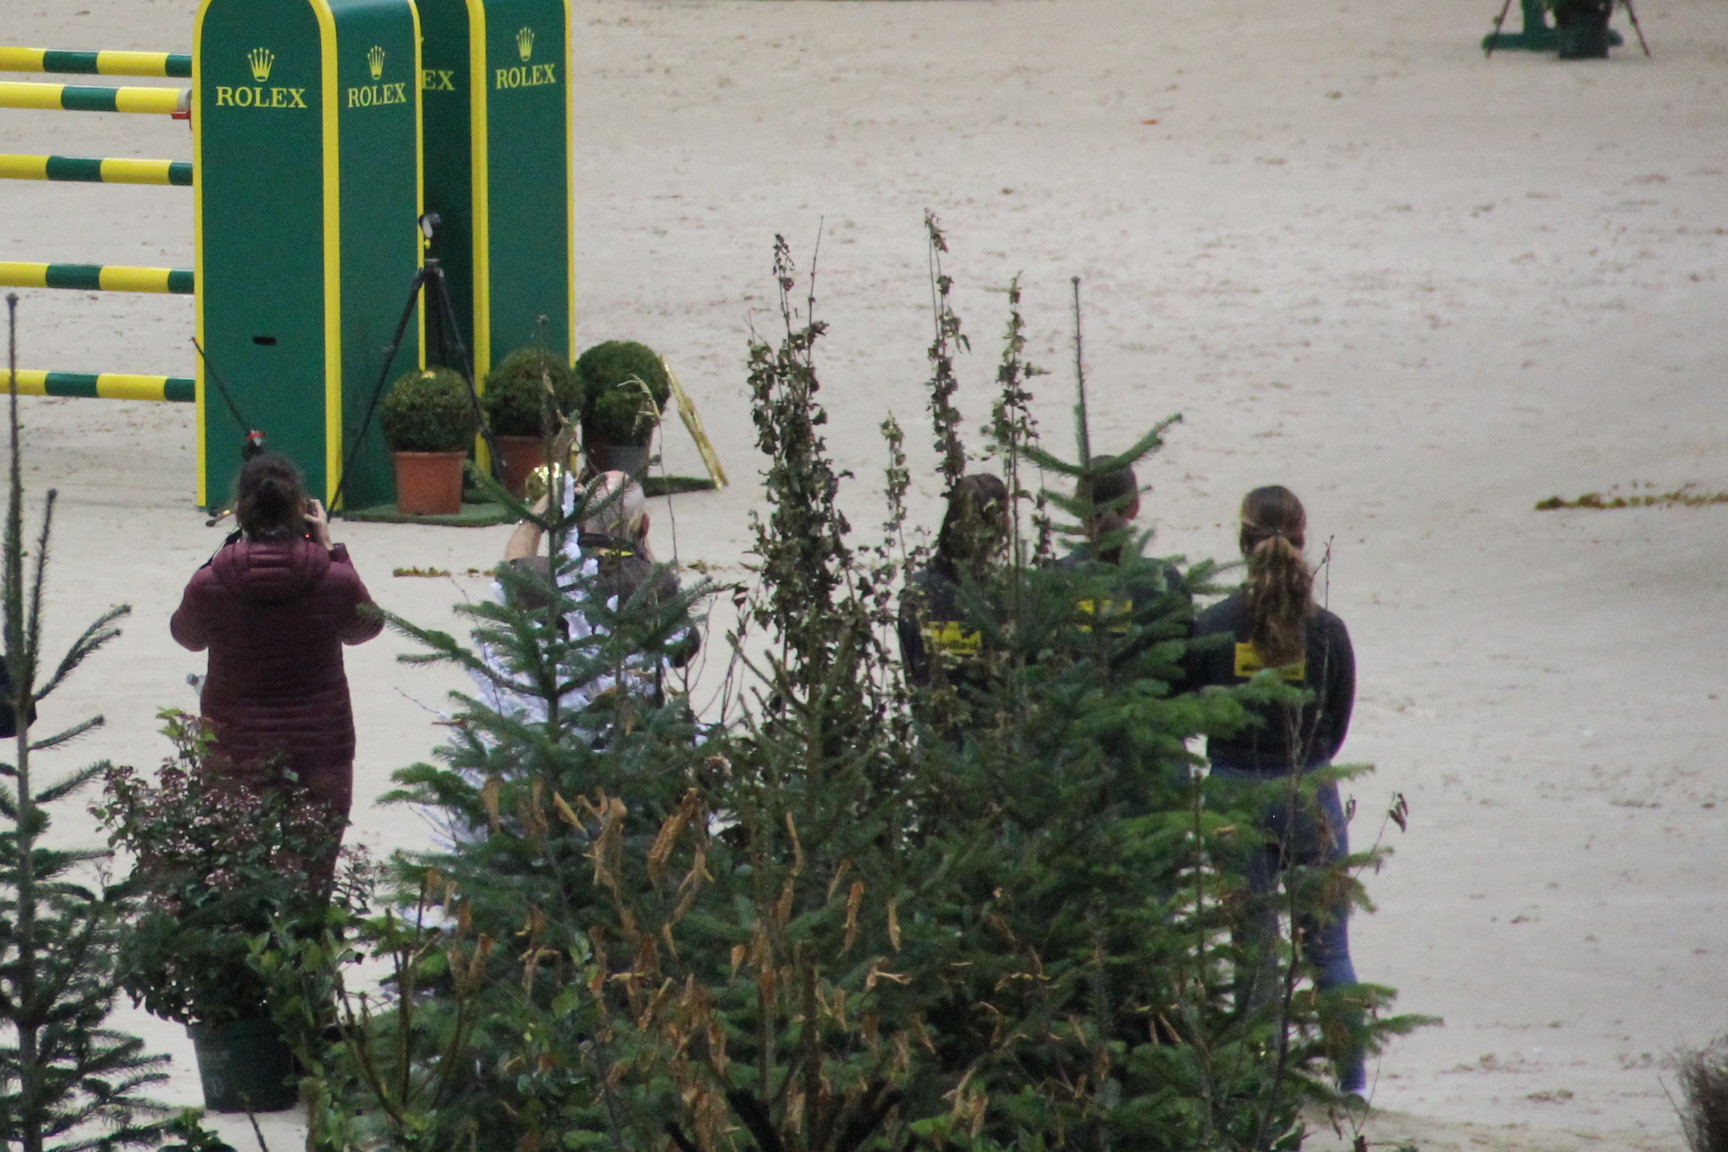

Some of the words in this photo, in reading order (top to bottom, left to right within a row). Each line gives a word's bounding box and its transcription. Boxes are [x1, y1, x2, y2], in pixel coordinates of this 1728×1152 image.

[495, 63, 556, 89] ROLEX
[215, 86, 307, 109] ROLEX
[347, 82, 407, 108] ROLEX
